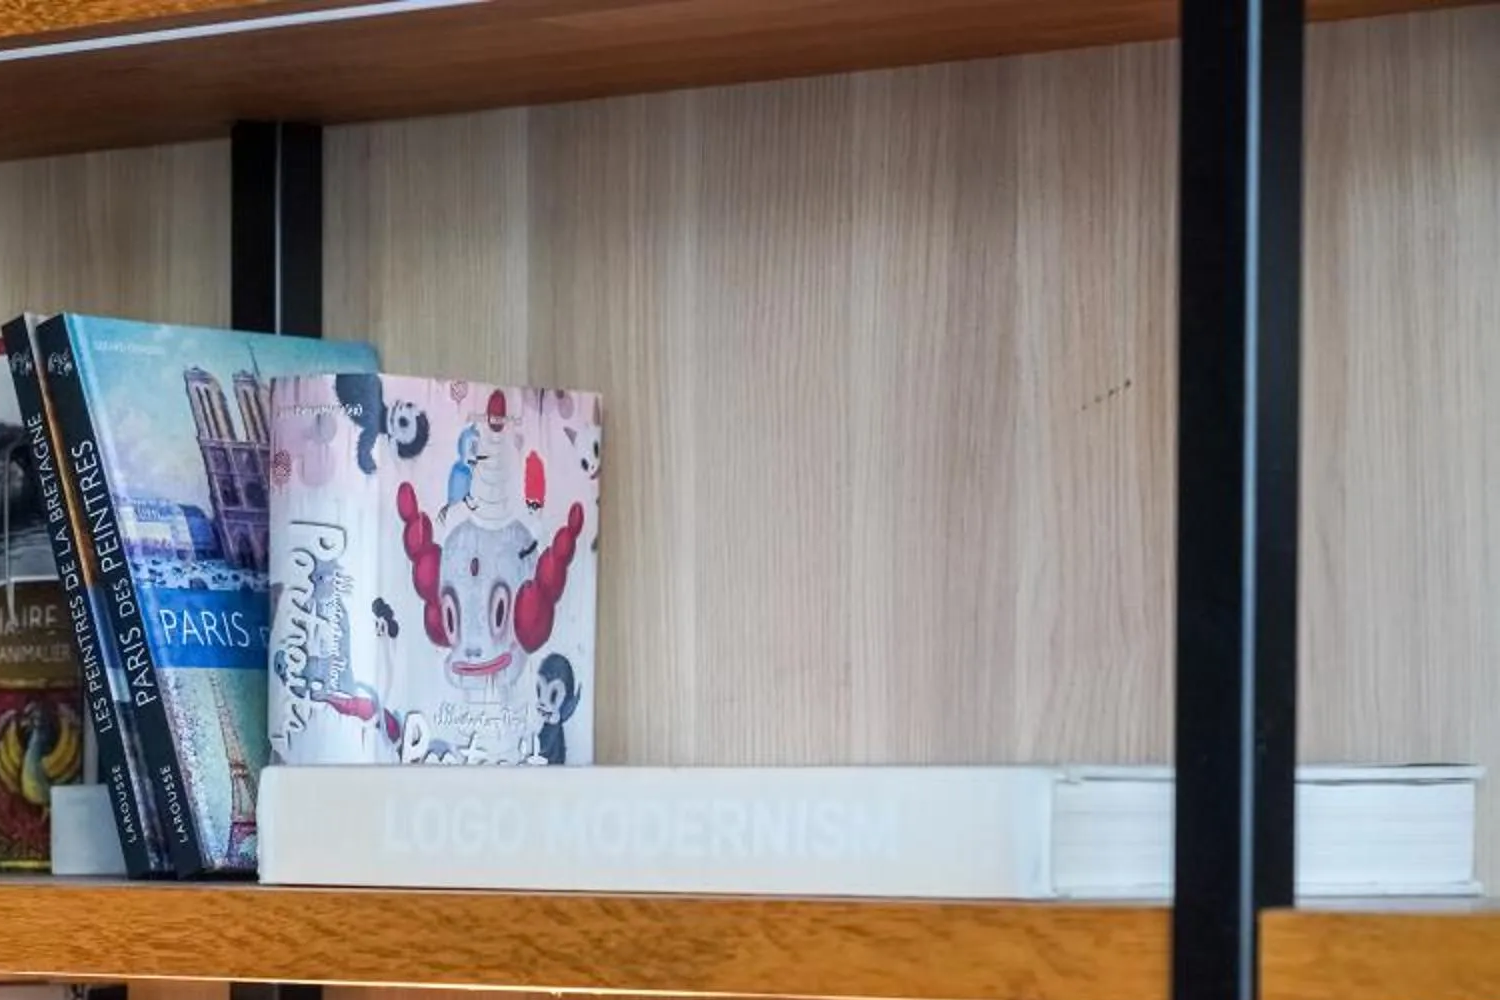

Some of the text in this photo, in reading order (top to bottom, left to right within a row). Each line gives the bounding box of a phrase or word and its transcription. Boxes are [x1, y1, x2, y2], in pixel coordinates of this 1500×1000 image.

[27, 412, 114, 732] LES PEINTRES DE LA BRETAGNE
[71, 440, 158, 708] PARIS DES PEINTRES
[160, 608, 250, 648] PARIS
[112, 765, 135, 844] LAROUSSE
[159, 765, 189, 844] LAROUSSE
[381, 793, 901, 861] LOGO MODERNISM
